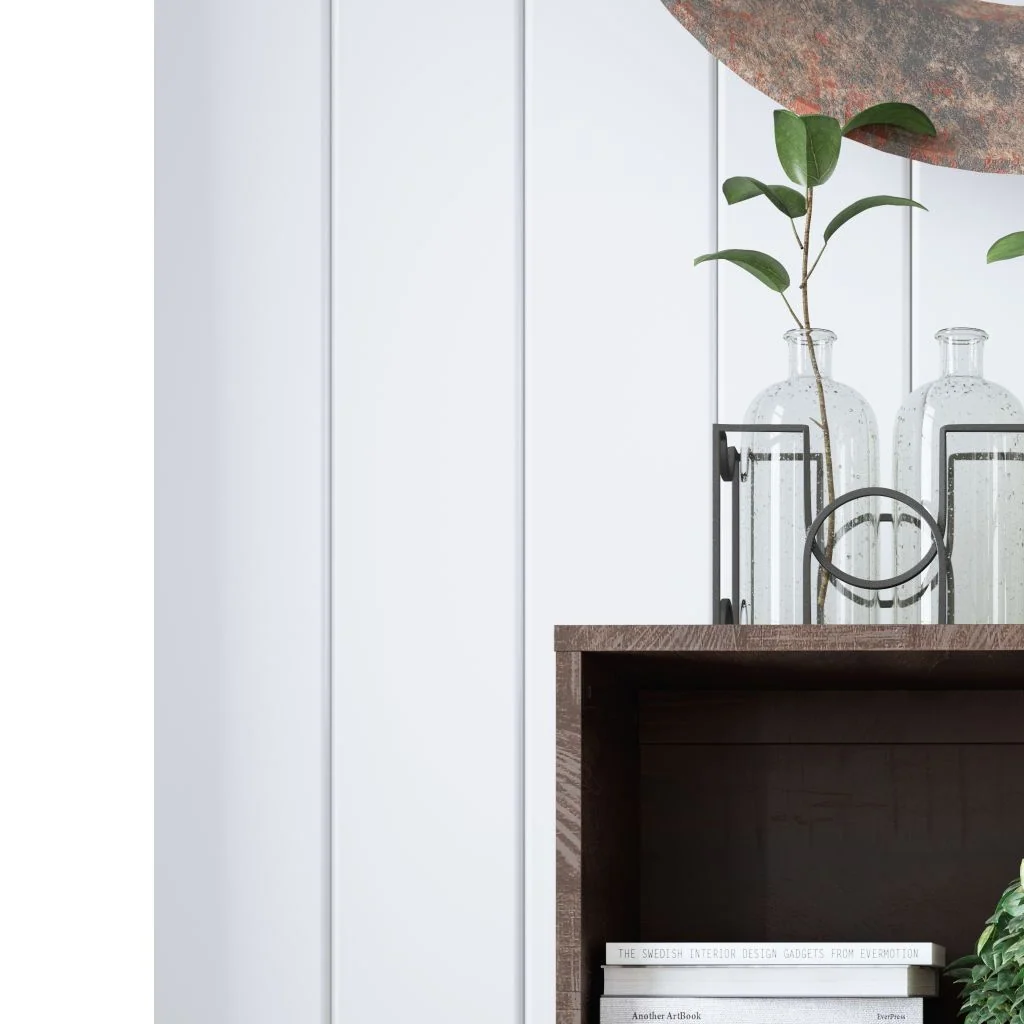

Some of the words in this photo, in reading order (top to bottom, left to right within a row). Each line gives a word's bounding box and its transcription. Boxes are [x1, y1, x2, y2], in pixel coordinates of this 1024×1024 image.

[618, 948, 636, 959] THE
[641, 948, 683, 959] SWEDISH
[689, 948, 736, 959] INTERIOR
[742, 948, 777, 959] DESIGN
[783, 948, 825, 959] GADGETS
[831, 948, 855, 959] FROM
[859, 948, 919, 959] EVERMOTION
[631, 1011, 665, 1020] Another
[666, 1011, 701, 1020] ArtBook
